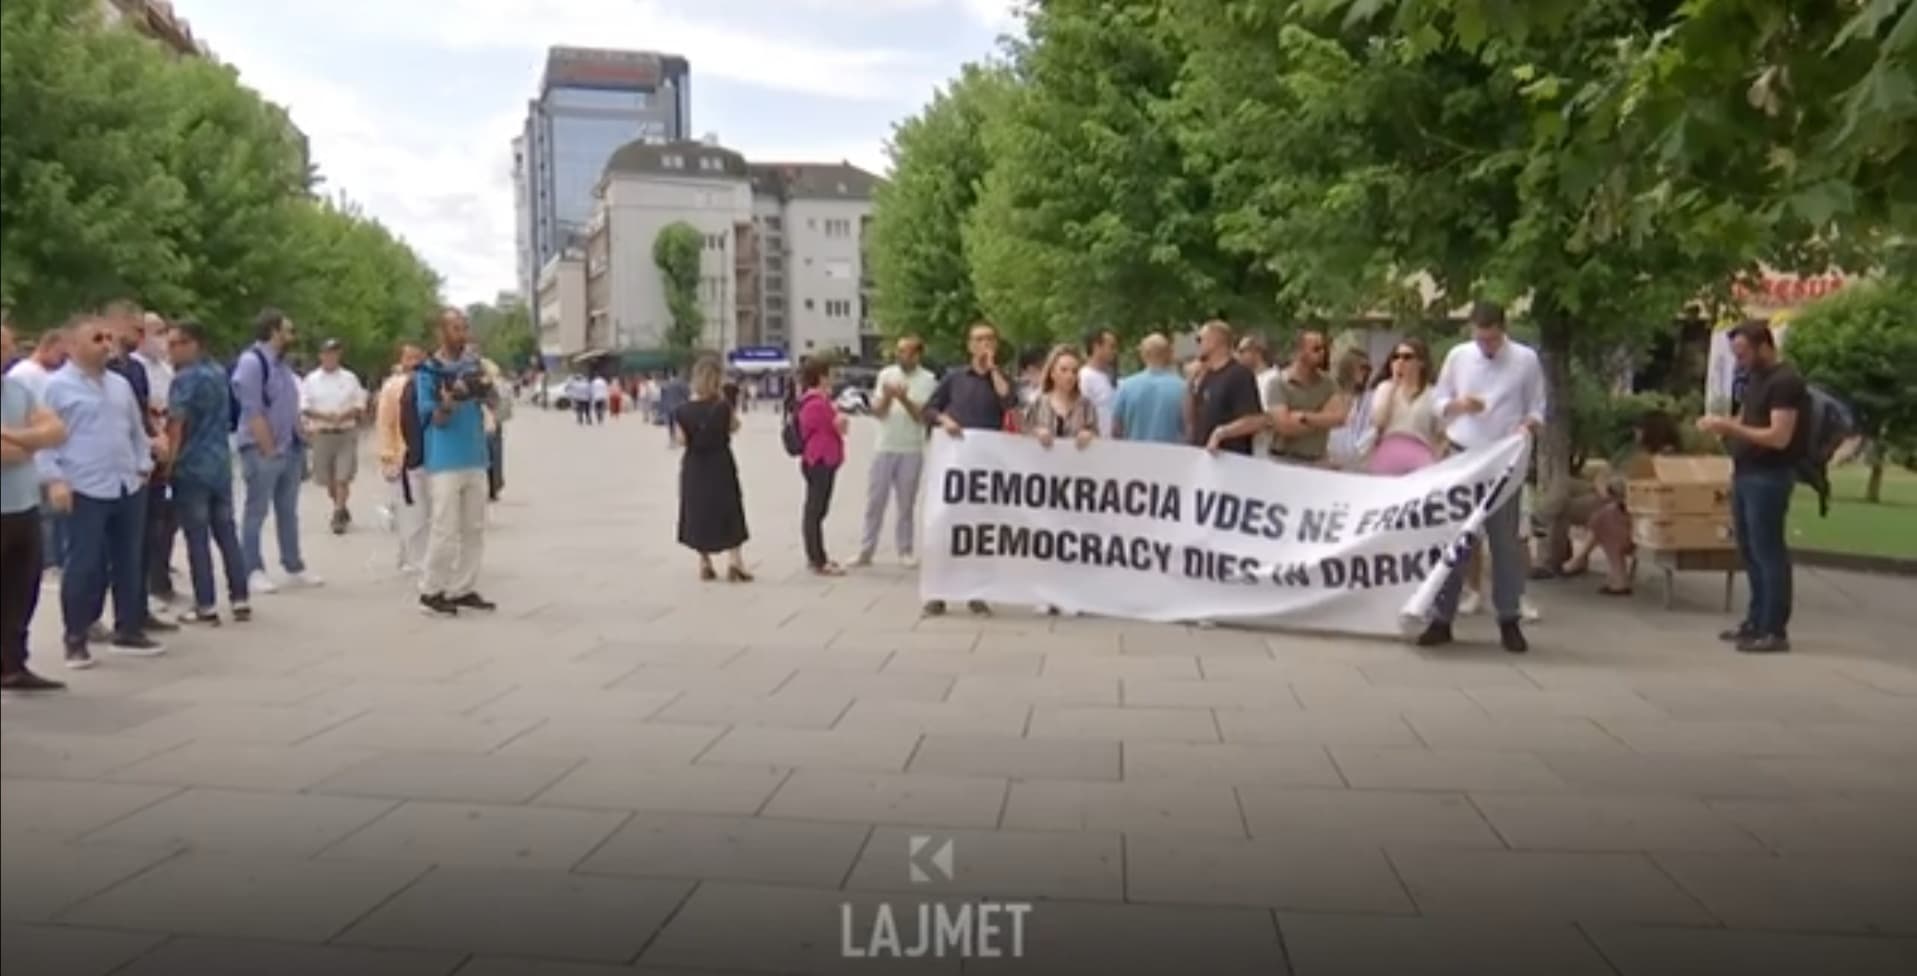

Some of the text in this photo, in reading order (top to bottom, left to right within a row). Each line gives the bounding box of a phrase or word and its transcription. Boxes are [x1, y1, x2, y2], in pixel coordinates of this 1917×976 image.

[943, 468, 1181, 522] DEMOKRACIA
[1195, 488, 1289, 540] VDES
[1297, 502, 1350, 543] NË
[951, 523, 1171, 574] DEMOCRACY
[1183, 546, 1260, 586] DIES
